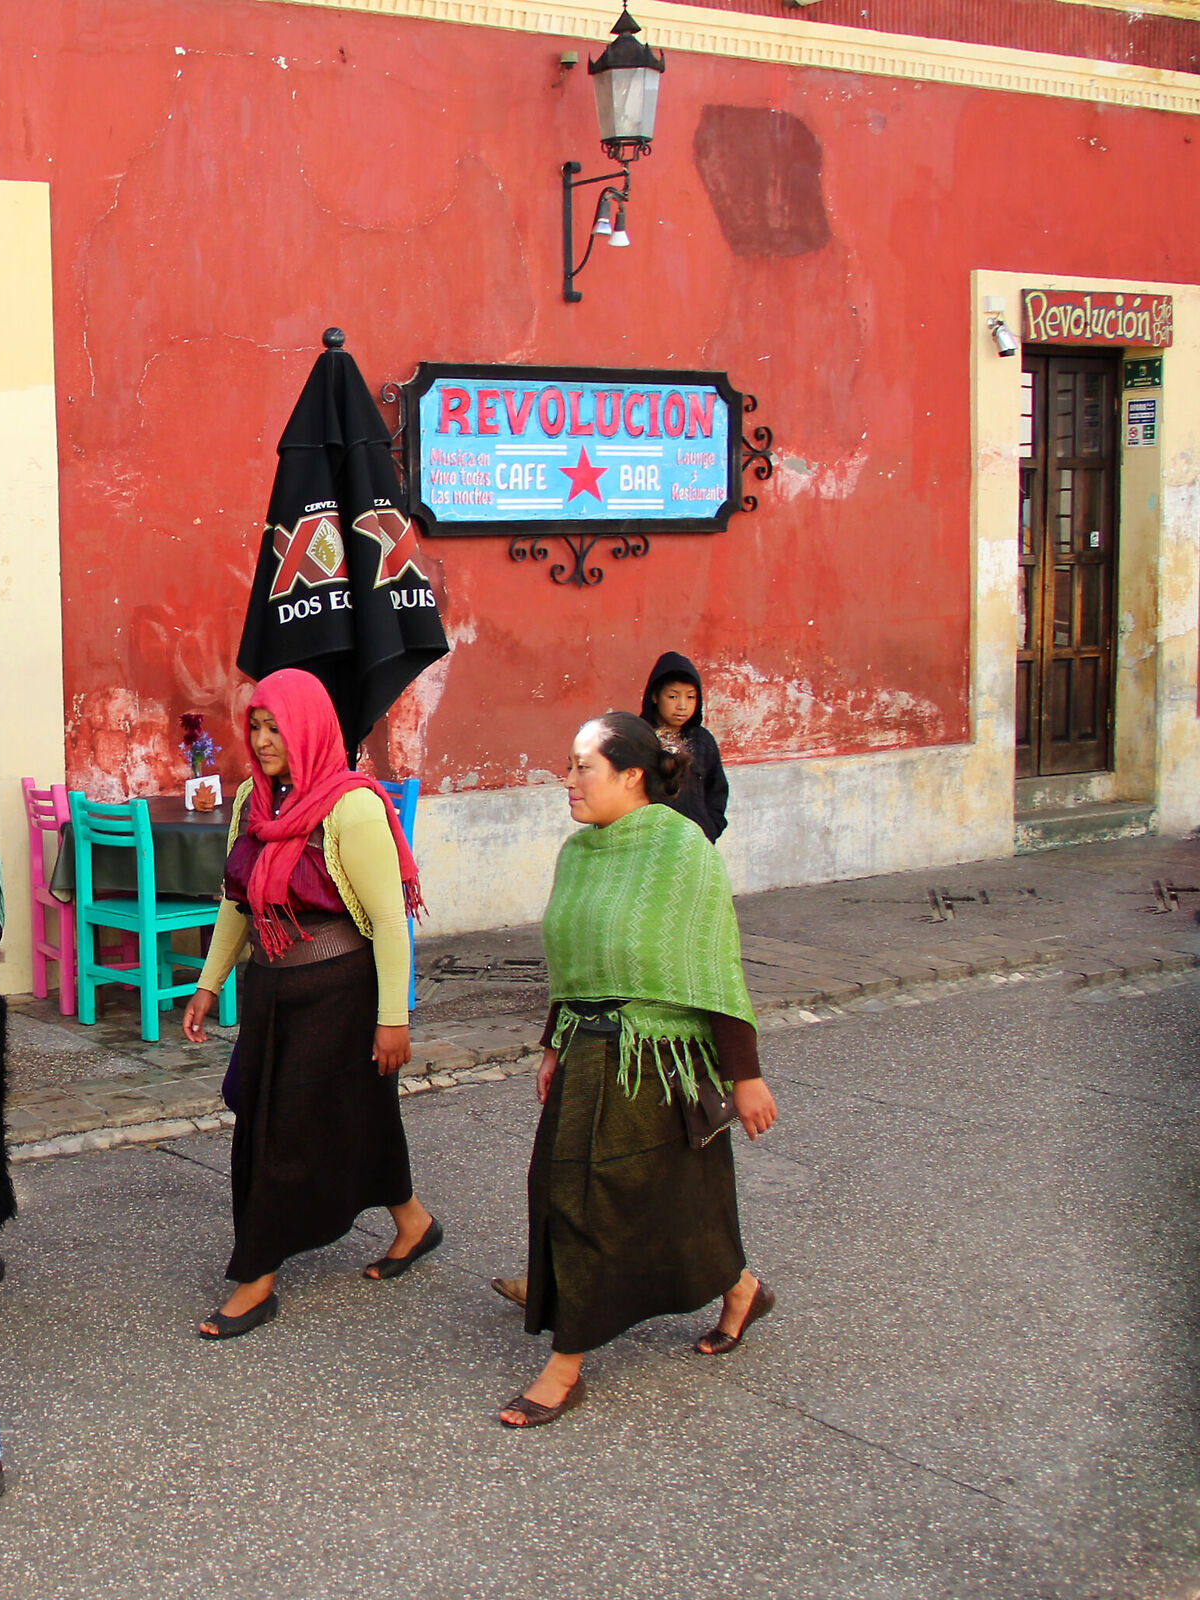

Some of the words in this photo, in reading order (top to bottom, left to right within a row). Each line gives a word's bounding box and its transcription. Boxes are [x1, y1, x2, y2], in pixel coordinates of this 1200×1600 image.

[1025, 292, 1151, 341] Revolución
[437, 386, 717, 437] REVOLUCION
[477, 453, 491, 466] en
[677, 448, 716, 469] Lounge
[496, 463, 547, 490] CAFE
[620, 465, 661, 491] BAR
[304, 500, 338, 513] CERVEZ
[431, 488, 450, 504] Las
[453, 488, 494, 505] noches
[278, 595, 323, 625] DOS
[389, 588, 437, 610] QUIS
